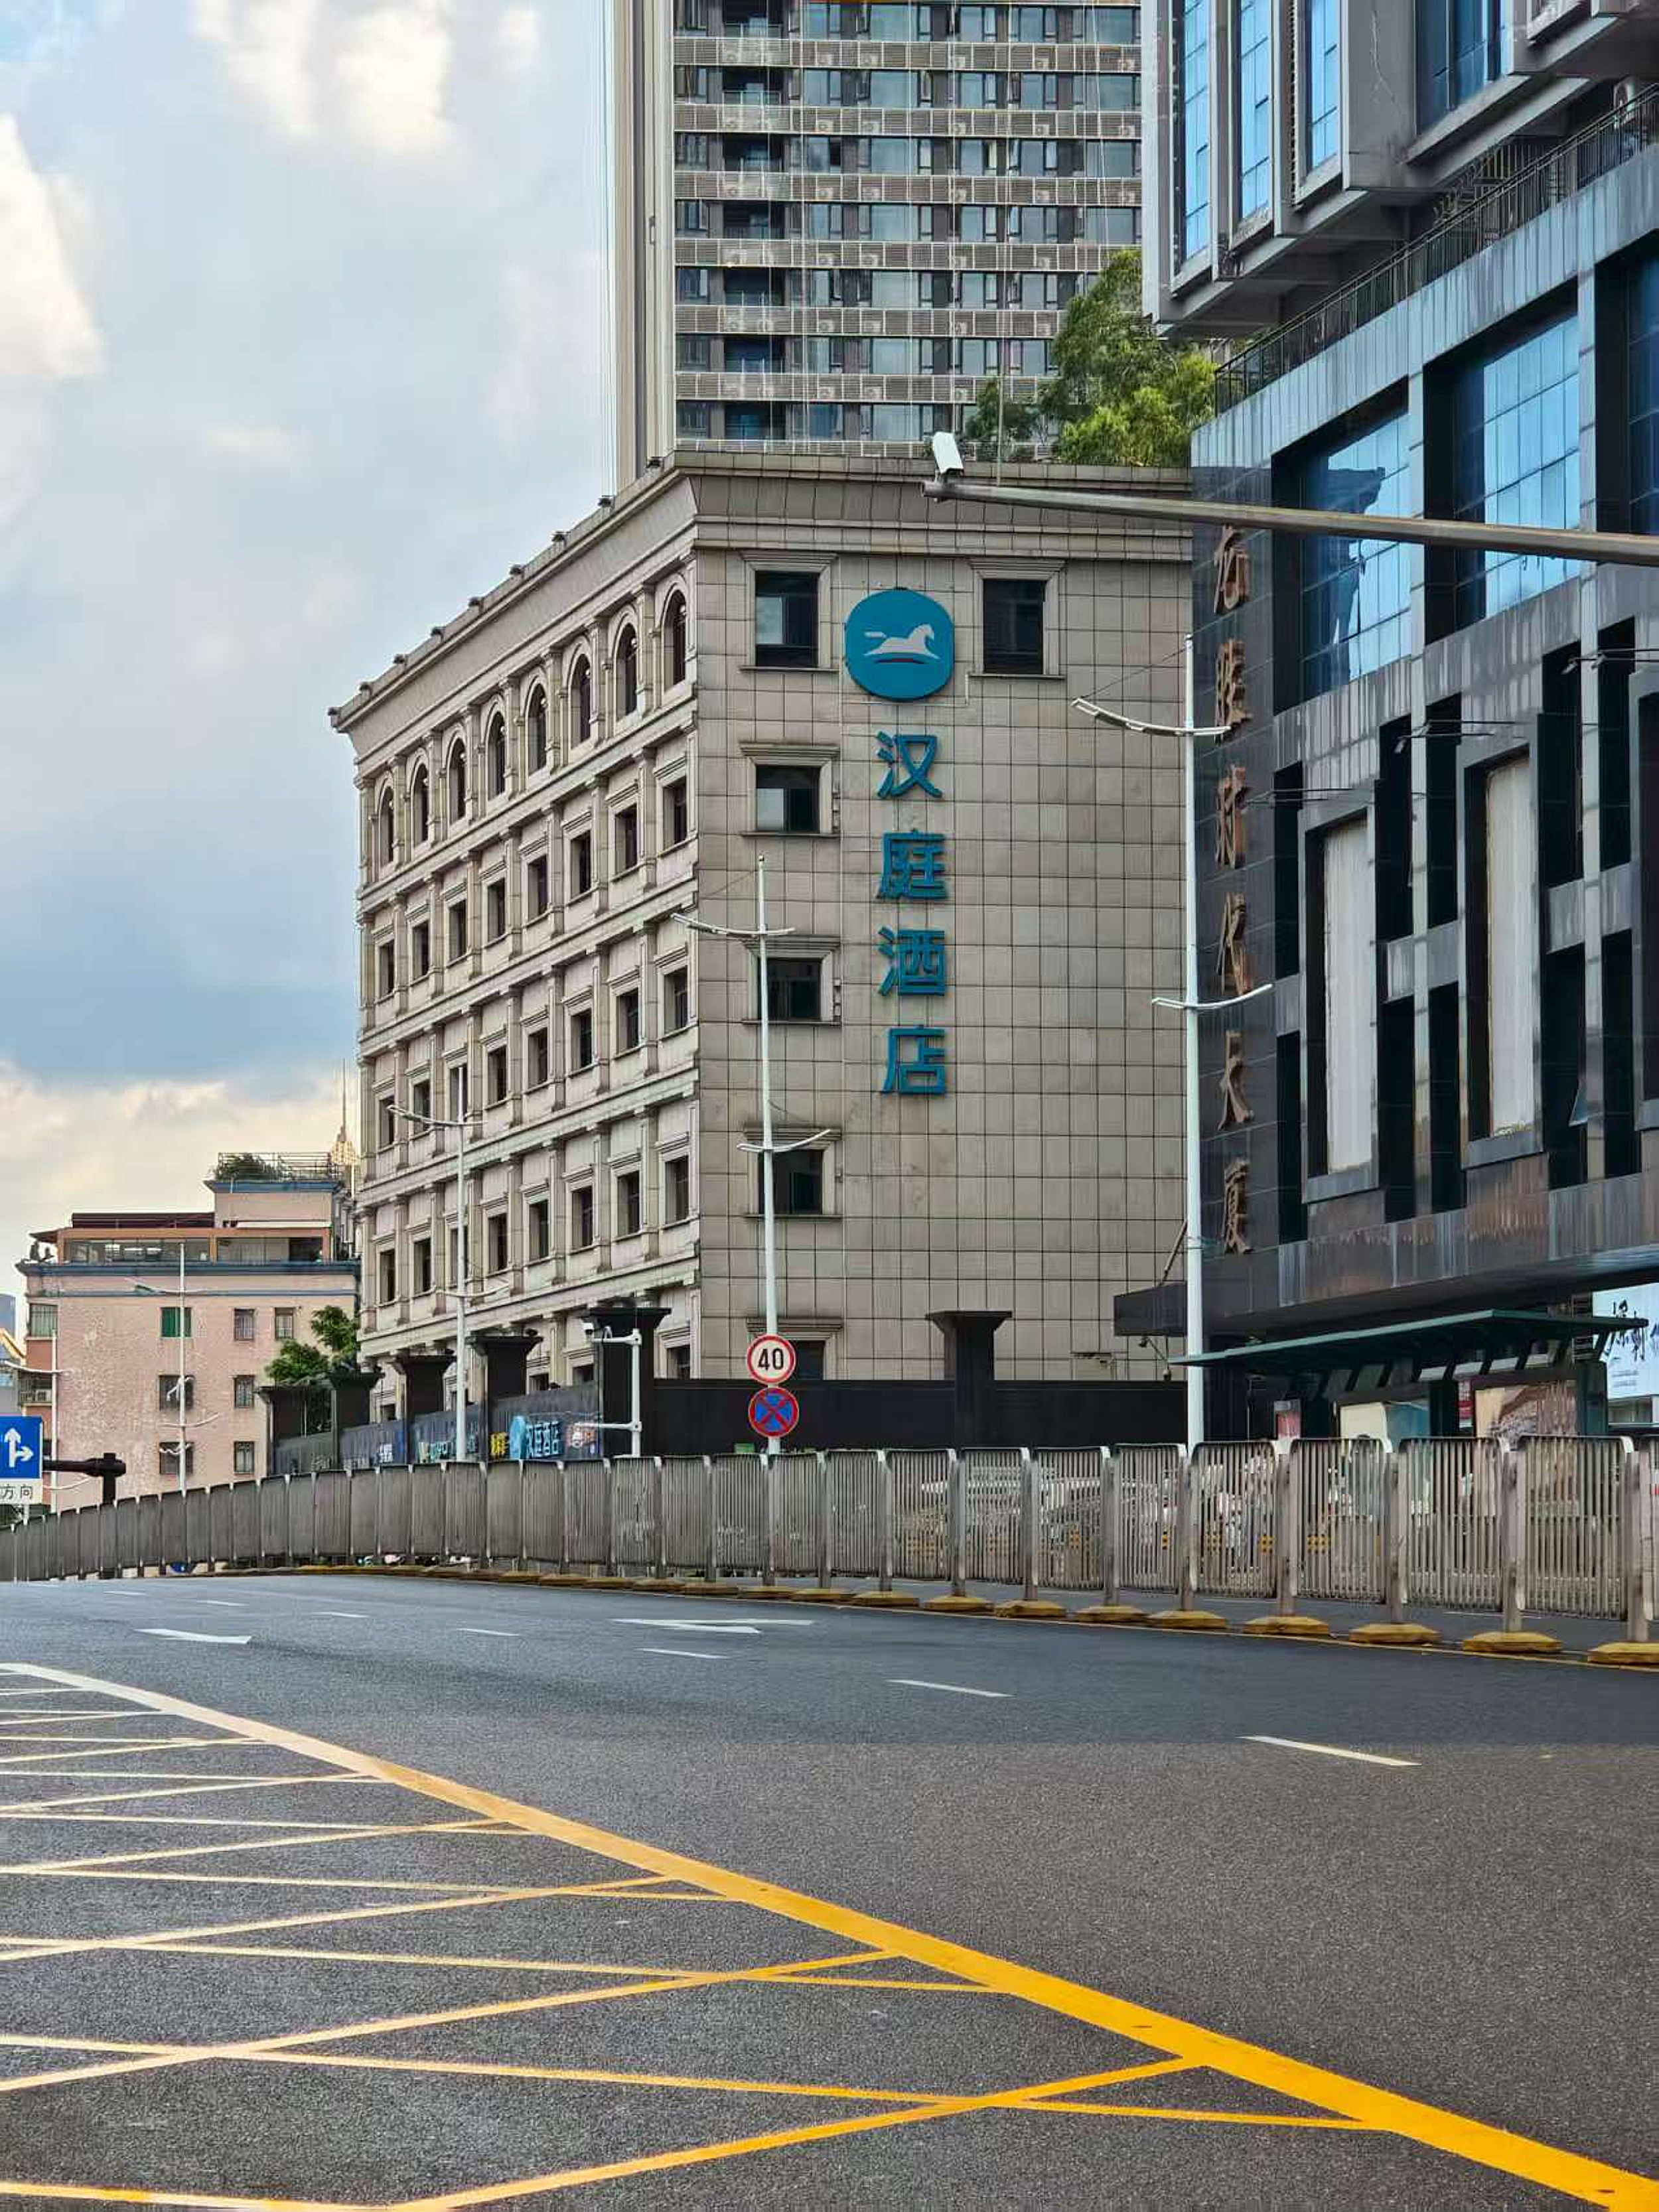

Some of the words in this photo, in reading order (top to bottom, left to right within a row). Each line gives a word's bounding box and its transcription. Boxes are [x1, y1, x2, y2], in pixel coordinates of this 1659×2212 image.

[875, 730, 949, 1096] 汉庭酒店
[757, 1348, 784, 1371] 40
